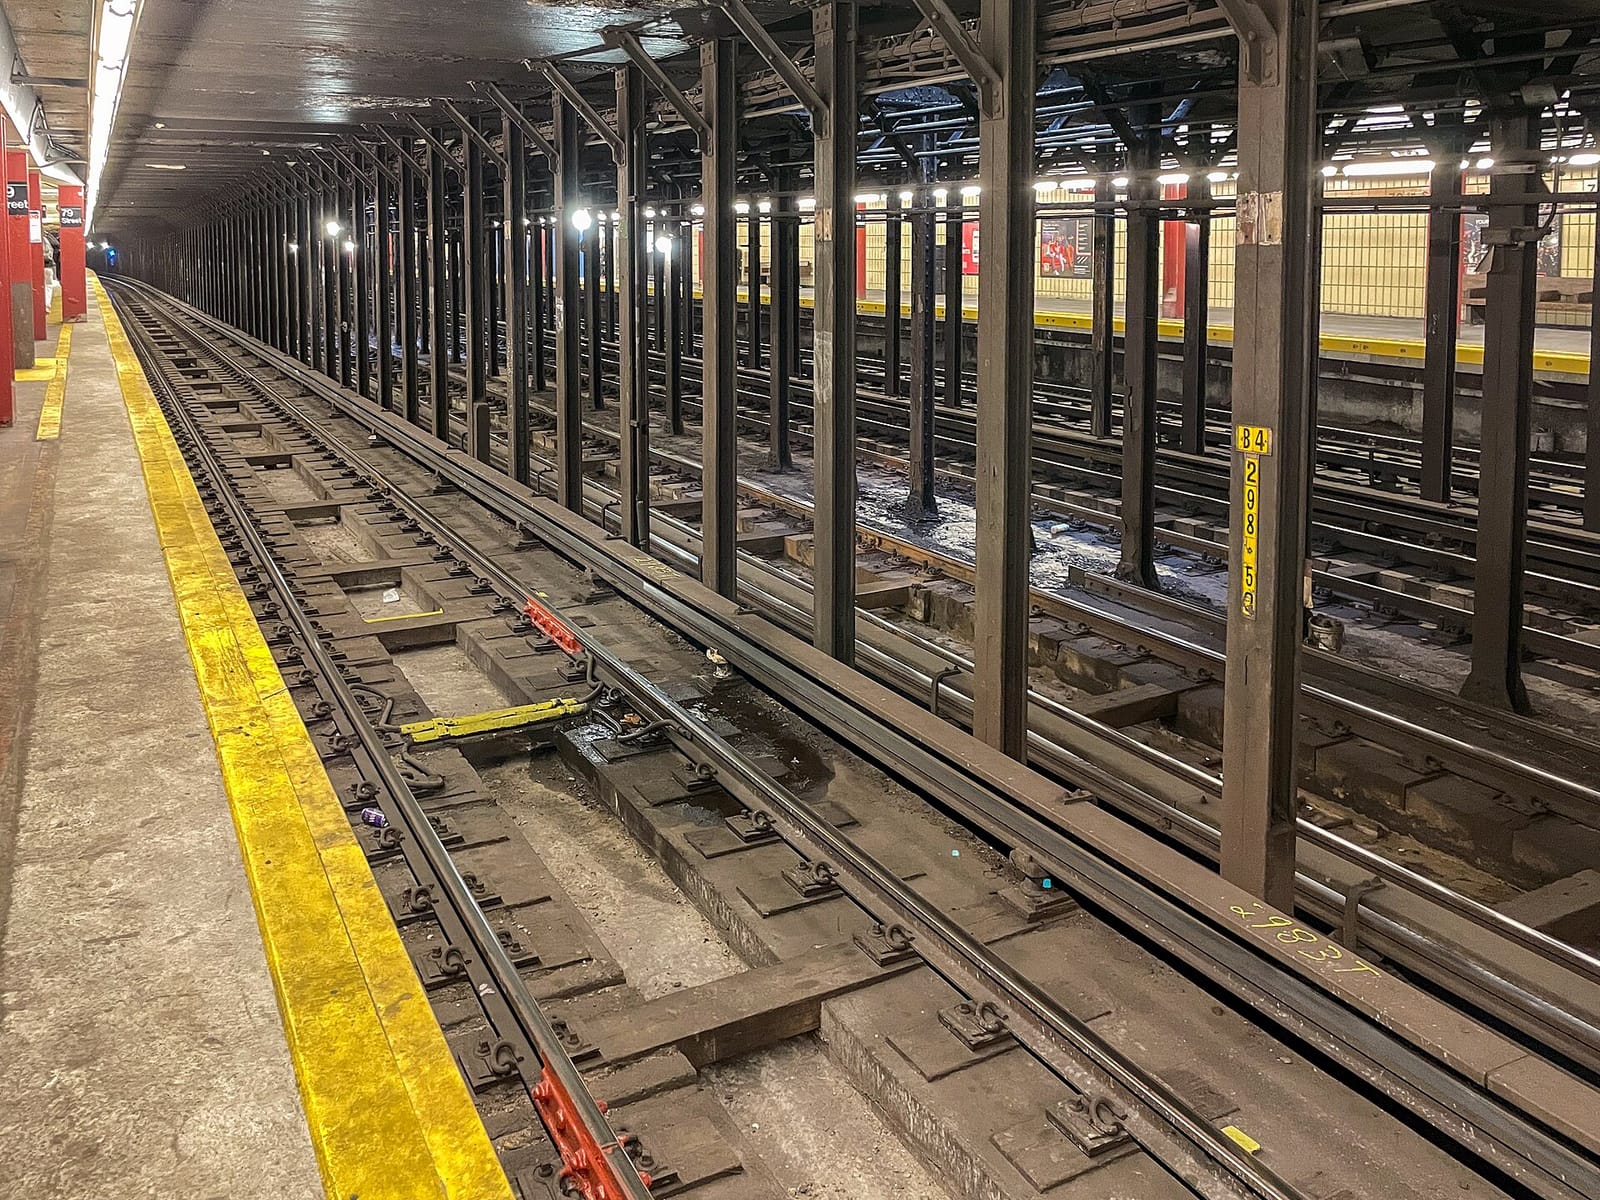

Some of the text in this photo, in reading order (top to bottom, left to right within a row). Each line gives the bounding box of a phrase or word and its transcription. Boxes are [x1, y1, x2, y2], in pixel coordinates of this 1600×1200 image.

[6, 186, 15, 198] 9
[7, 199, 29, 209] reet
[61, 209, 74, 217] 79
